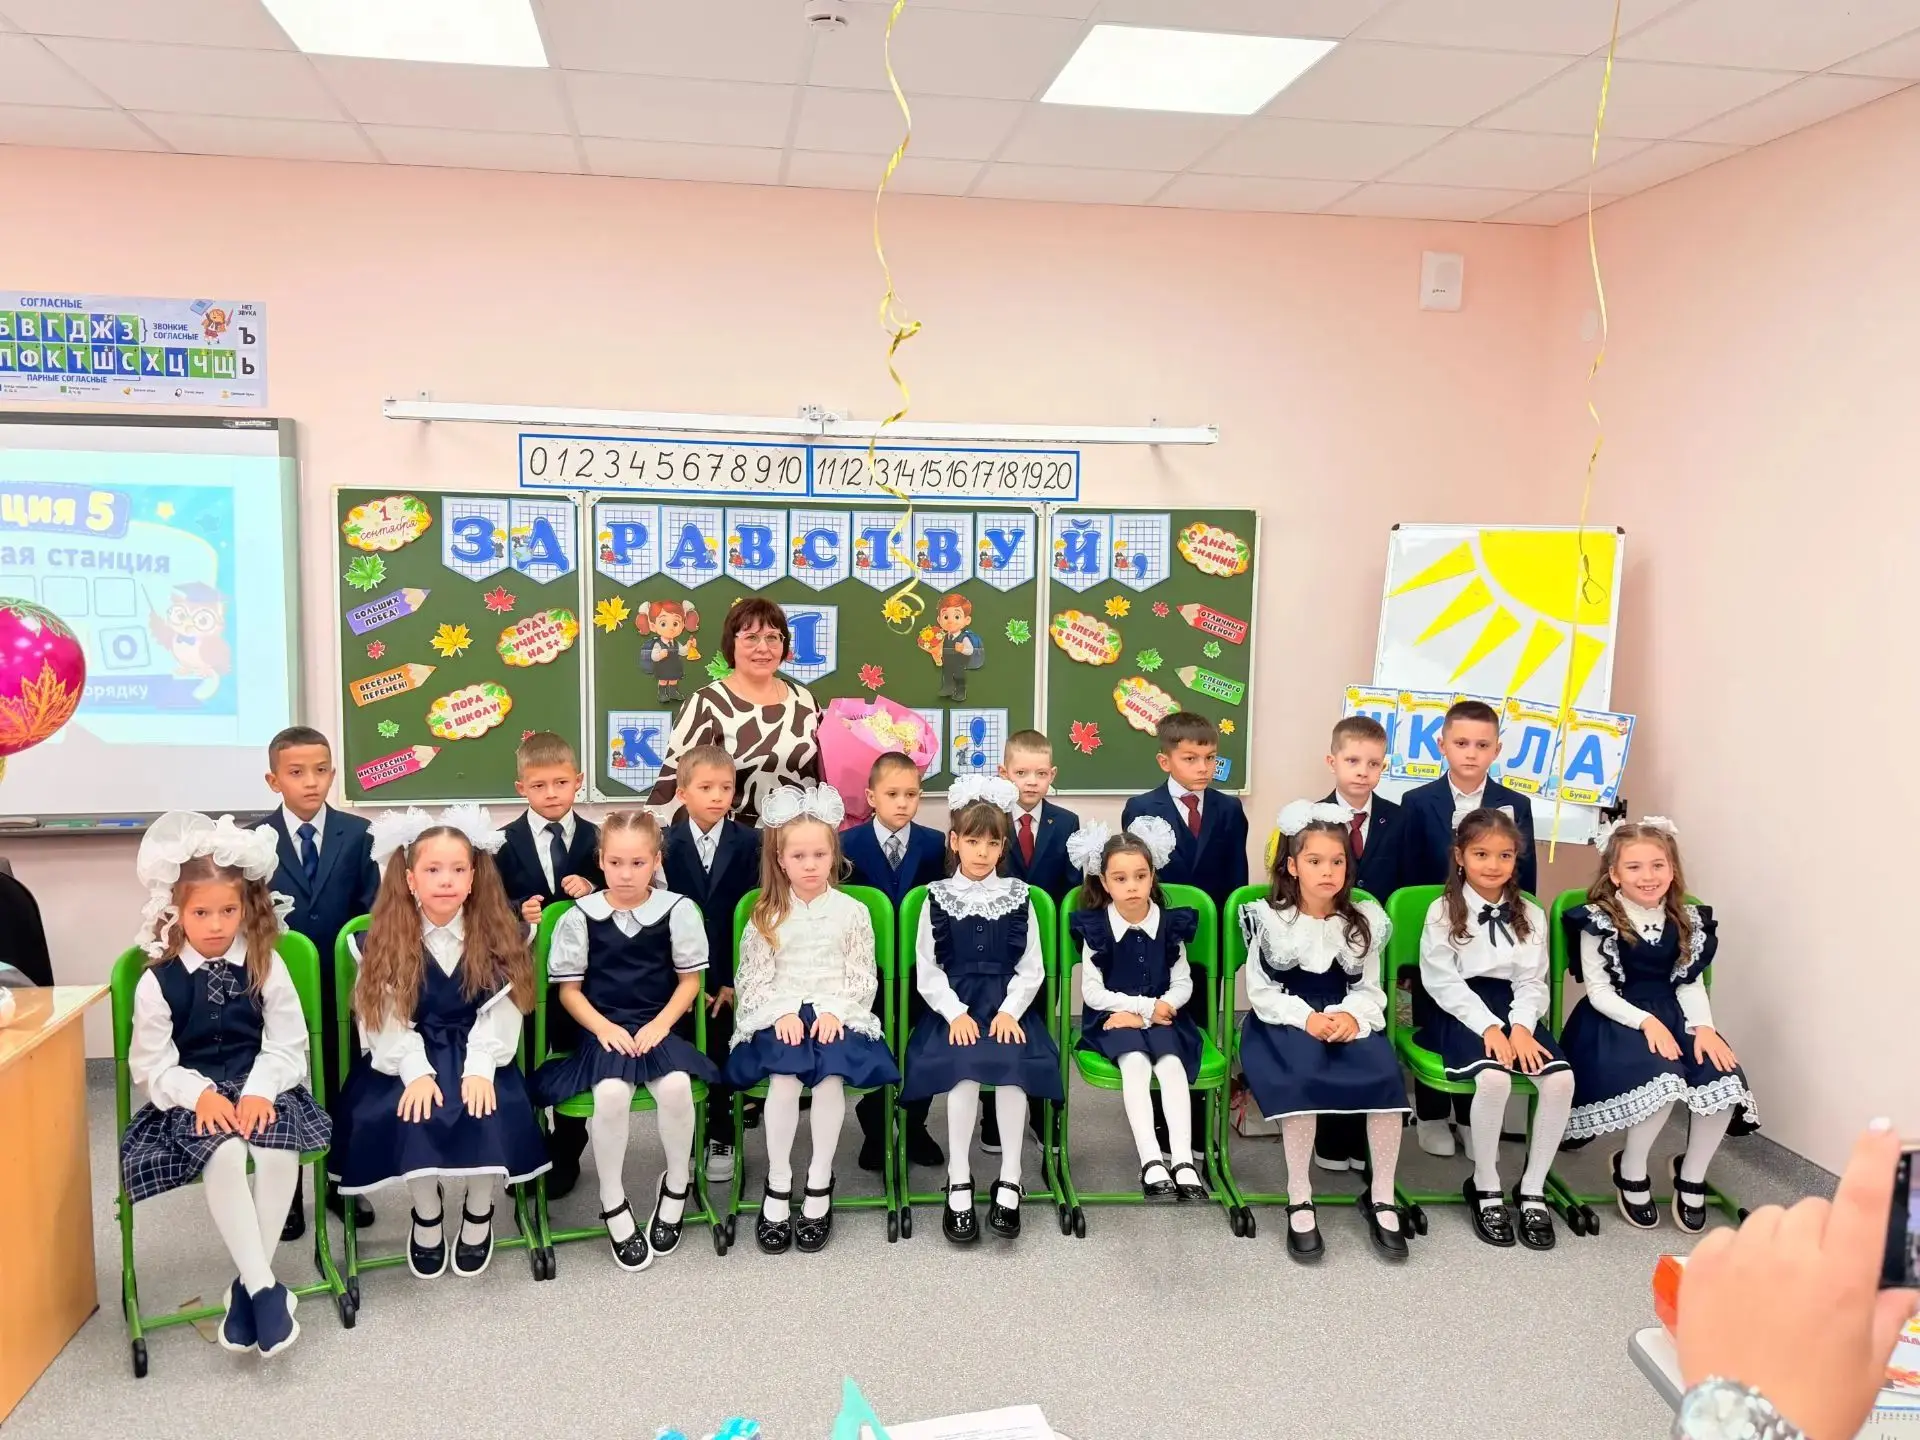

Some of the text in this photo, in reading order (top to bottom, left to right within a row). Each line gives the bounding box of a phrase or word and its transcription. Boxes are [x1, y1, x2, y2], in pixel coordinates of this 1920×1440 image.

[20, 297, 83, 309] СОГЛАСНЫЕ
[152, 323, 188, 332] ЗВОНКИЕ
[153, 331, 199, 341] СОГЛАСНЫЕ
[238, 327, 256, 344] Ъ
[242, 357, 255, 375] Ь
[26, 374, 108, 384] ПАРНЫЕ СОГЛАСНЫЕ
[529, 447, 802, 484] 0 1 2 3 4 5 6 7 8 9 10
[86, 491, 114, 531] 5
[379, 505, 391, 521] 1
[360, 516, 417, 540] сентября
[1188, 530, 1236, 554] С ДНЁМ
[47, 547, 170, 576] станция
[1191, 546, 1239, 570] ЗНАНИЙ!
[354, 596, 400, 621] БОЛЬШИХ
[364, 607, 400, 627] ПОБЕД!
[516, 616, 547, 636] БУДУ
[1200, 610, 1244, 632] ОТЛИЧНЫХ
[1202, 620, 1236, 639] ОЦЕНОК!
[511, 622, 565, 651] УЧИТЬСЯ
[1070, 622, 1106, 646] ВПЕРЁД
[527, 638, 561, 660] НА 5+
[1065, 633, 1110, 659] БУДУЩЕЕ
[359, 672, 403, 692] ВЕСЁЛЫХ
[362, 681, 408, 702] ПЕРЕМЕН!
[1199, 673, 1241, 694] УСПЕШНОГО
[1202, 682, 1232, 698] СТАРТА!
[84, 684, 149, 702] орядку
[1127, 684, 1169, 717] Здравству
[451, 694, 483, 713] ПОРА
[443, 702, 501, 731] В ШКОЛУ!
[357, 752, 413, 778] ИНТЕРЕСНЫХ
[371, 764, 406, 782] УРОКОВ!
[1412, 767, 1435, 776] Буква
[1508, 778, 1532, 790] Буква
[1568, 791, 1592, 800] Буква
